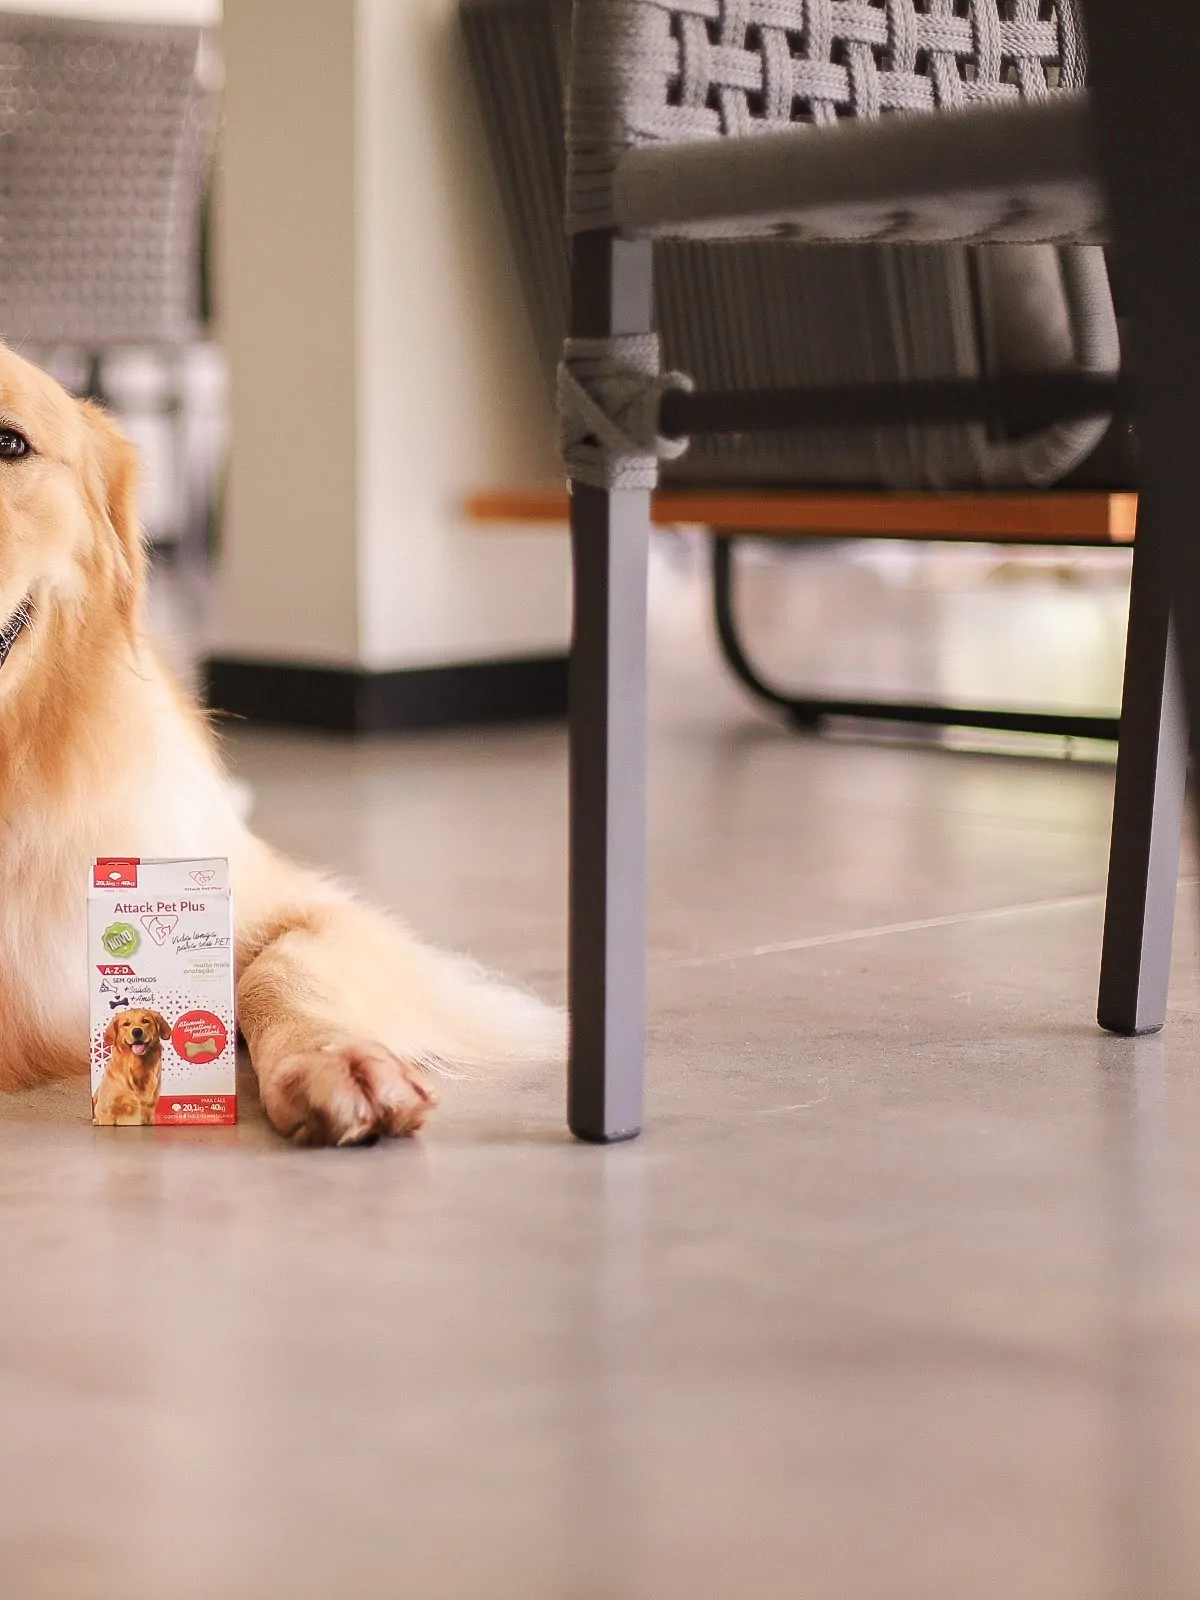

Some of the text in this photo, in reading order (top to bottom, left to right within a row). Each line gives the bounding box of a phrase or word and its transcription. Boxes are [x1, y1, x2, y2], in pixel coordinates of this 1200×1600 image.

[114, 901, 205, 913] Attack Pet Plus
[107, 929, 132, 951] NOVO
[214, 937, 230, 946] PET
